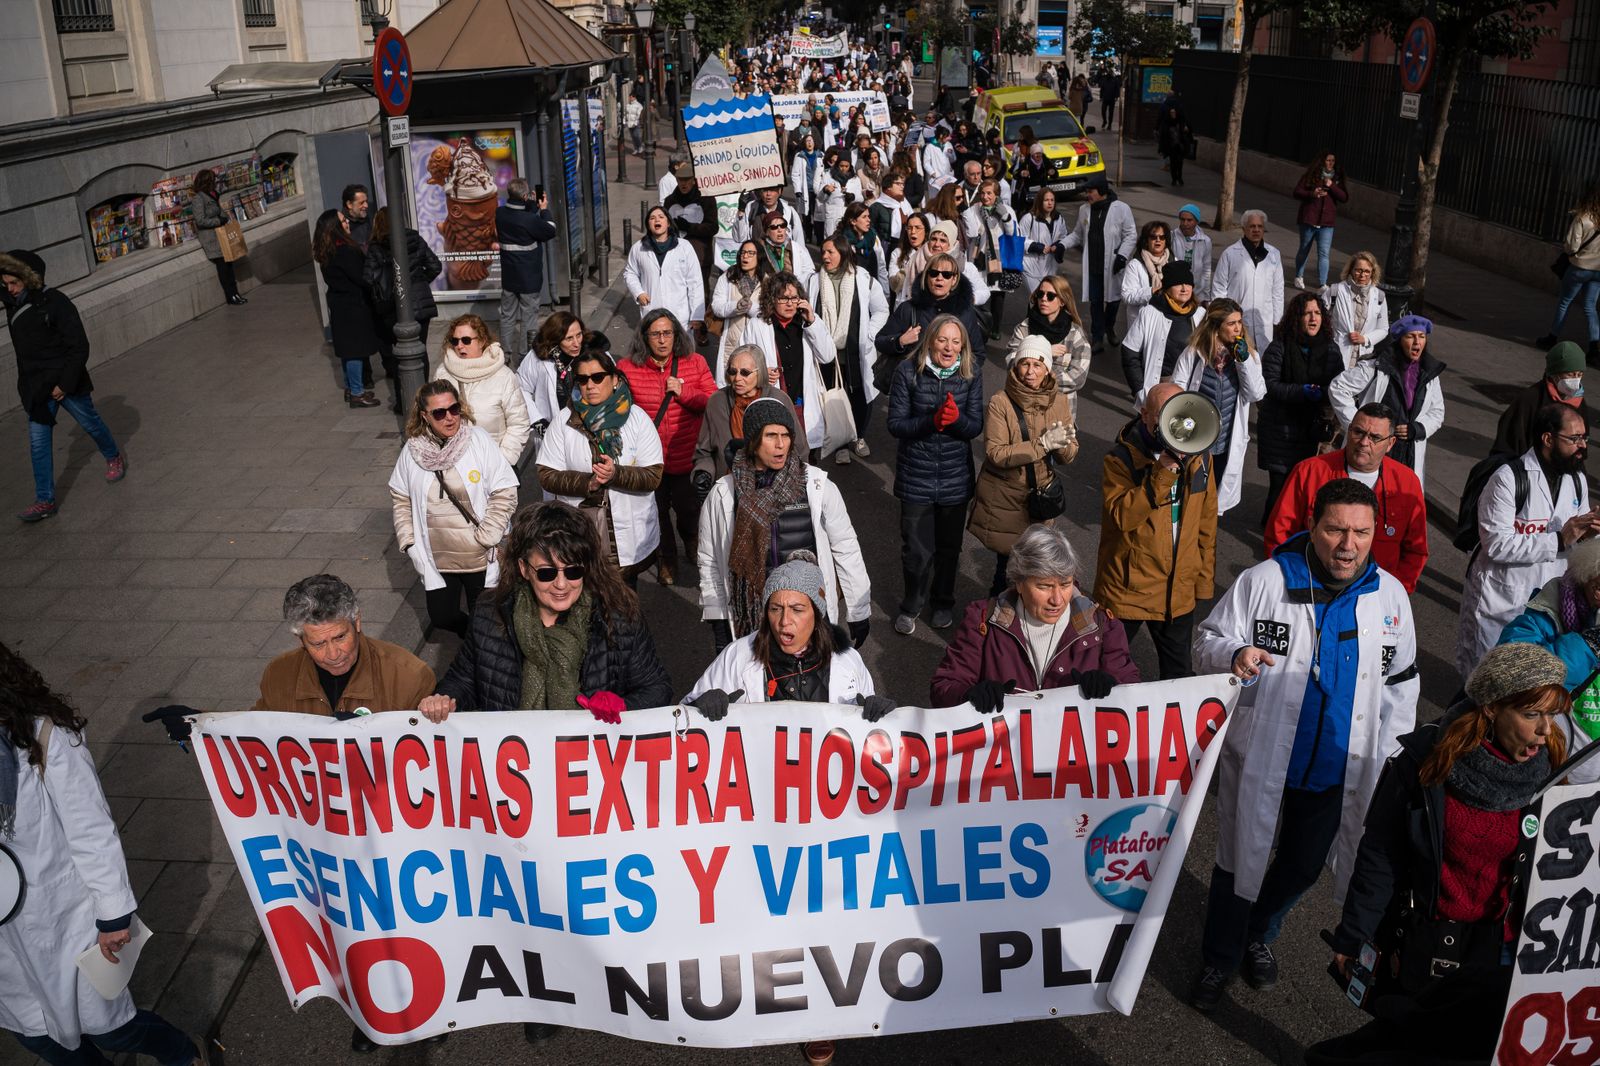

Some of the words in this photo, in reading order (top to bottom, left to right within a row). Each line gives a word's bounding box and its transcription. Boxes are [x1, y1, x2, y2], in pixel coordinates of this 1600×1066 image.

[693, 151, 733, 167] SANIDAD
[735, 143, 778, 160] LÍQUIDA
[695, 172, 736, 190] LIQUIDAR
[743, 164, 782, 182] SANIDAD
[1256, 635, 1288, 651] SUAP
[1584, 701, 1600, 710] SA
[1586, 688, 1600, 697] PO
[202, 732, 533, 838] URGENCIAS
[555, 725, 755, 838] EXTRA
[773, 697, 1228, 825] HOSPITALARIAS
[1089, 830, 1170, 857] Platafor
[1536, 790, 1600, 882] S
[241, 833, 657, 937] ESENCIALES
[680, 845, 730, 925] Y
[752, 821, 1052, 918] VITALES
[266, 905, 446, 1034] NO
[456, 945, 576, 1004] AL
[604, 936, 944, 1022] NUEVO
